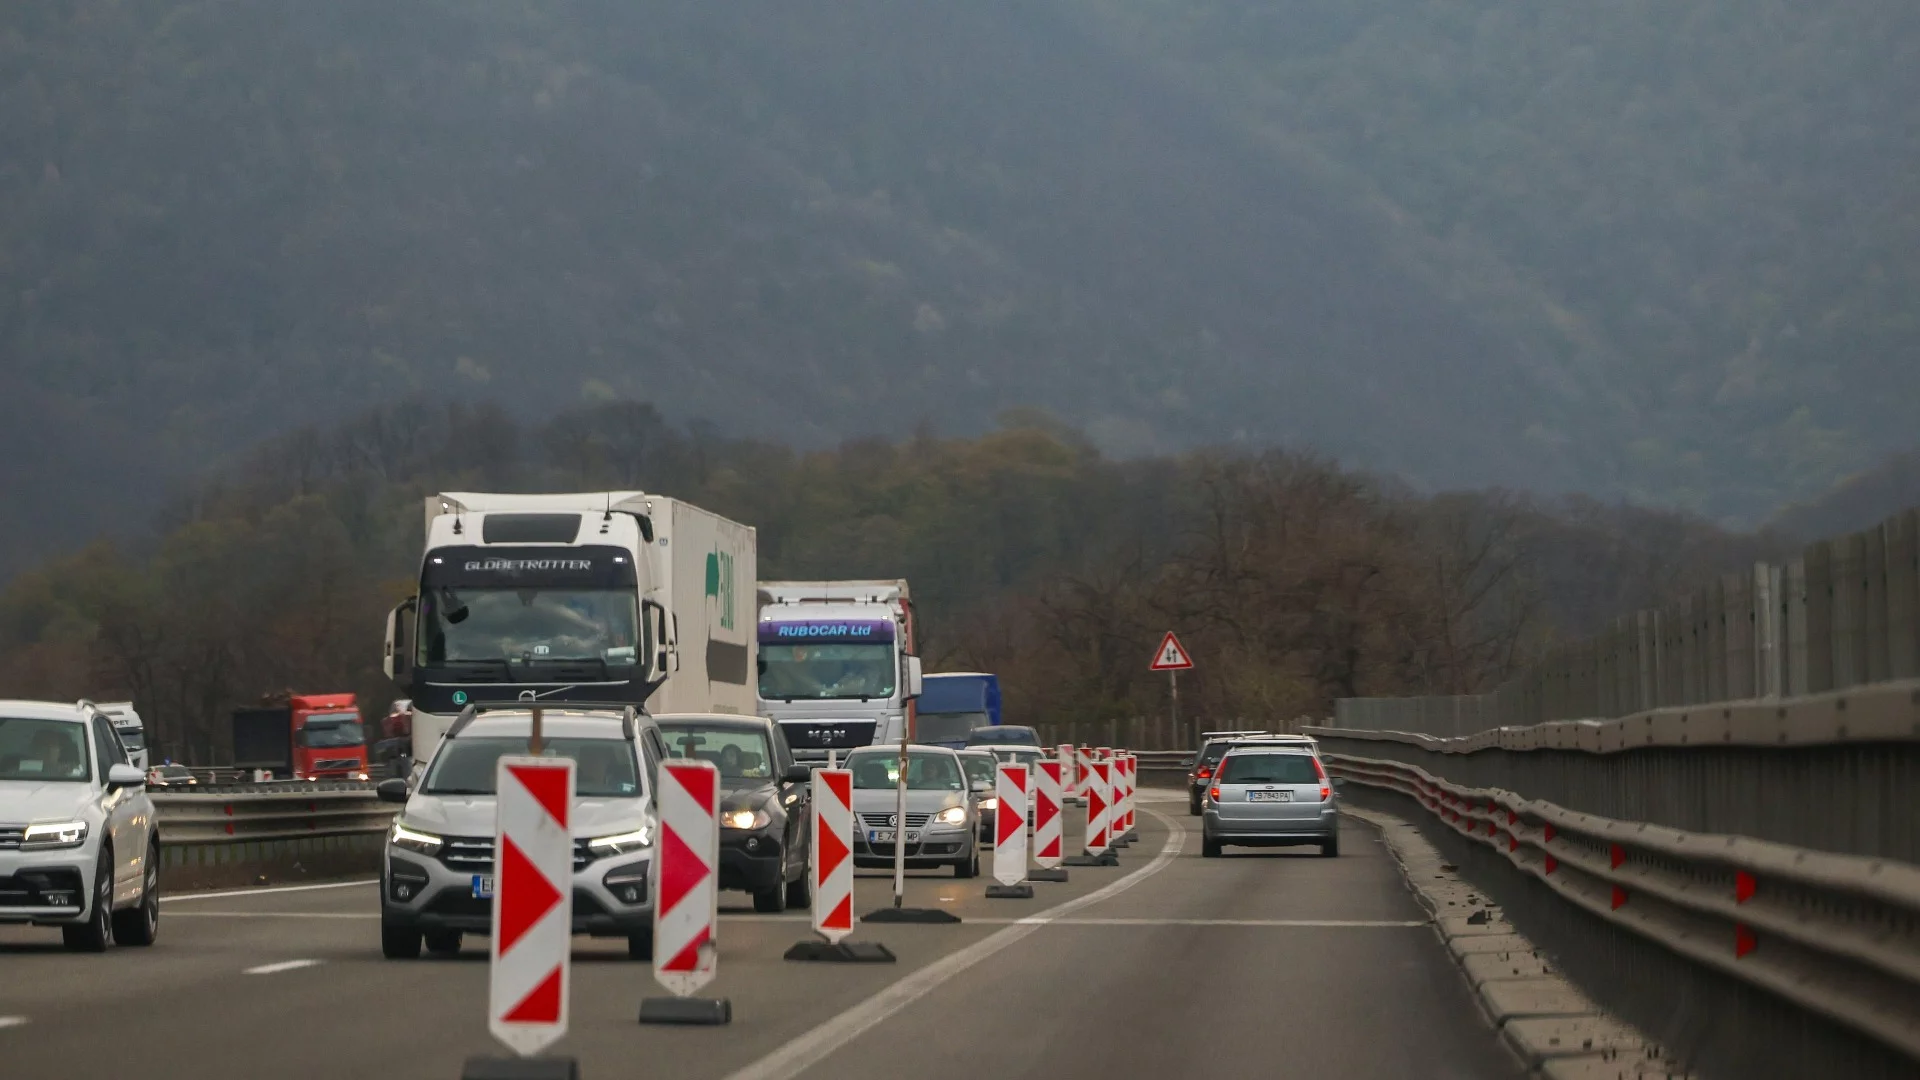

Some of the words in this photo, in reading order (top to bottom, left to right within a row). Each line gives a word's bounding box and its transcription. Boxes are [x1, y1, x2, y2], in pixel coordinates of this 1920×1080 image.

[464, 559, 592, 571] GLOBETROTTER
[778, 624, 848, 637] RUBOCAR
[850, 625, 872, 636] Ltd
[808, 730, 846, 738] MAN
